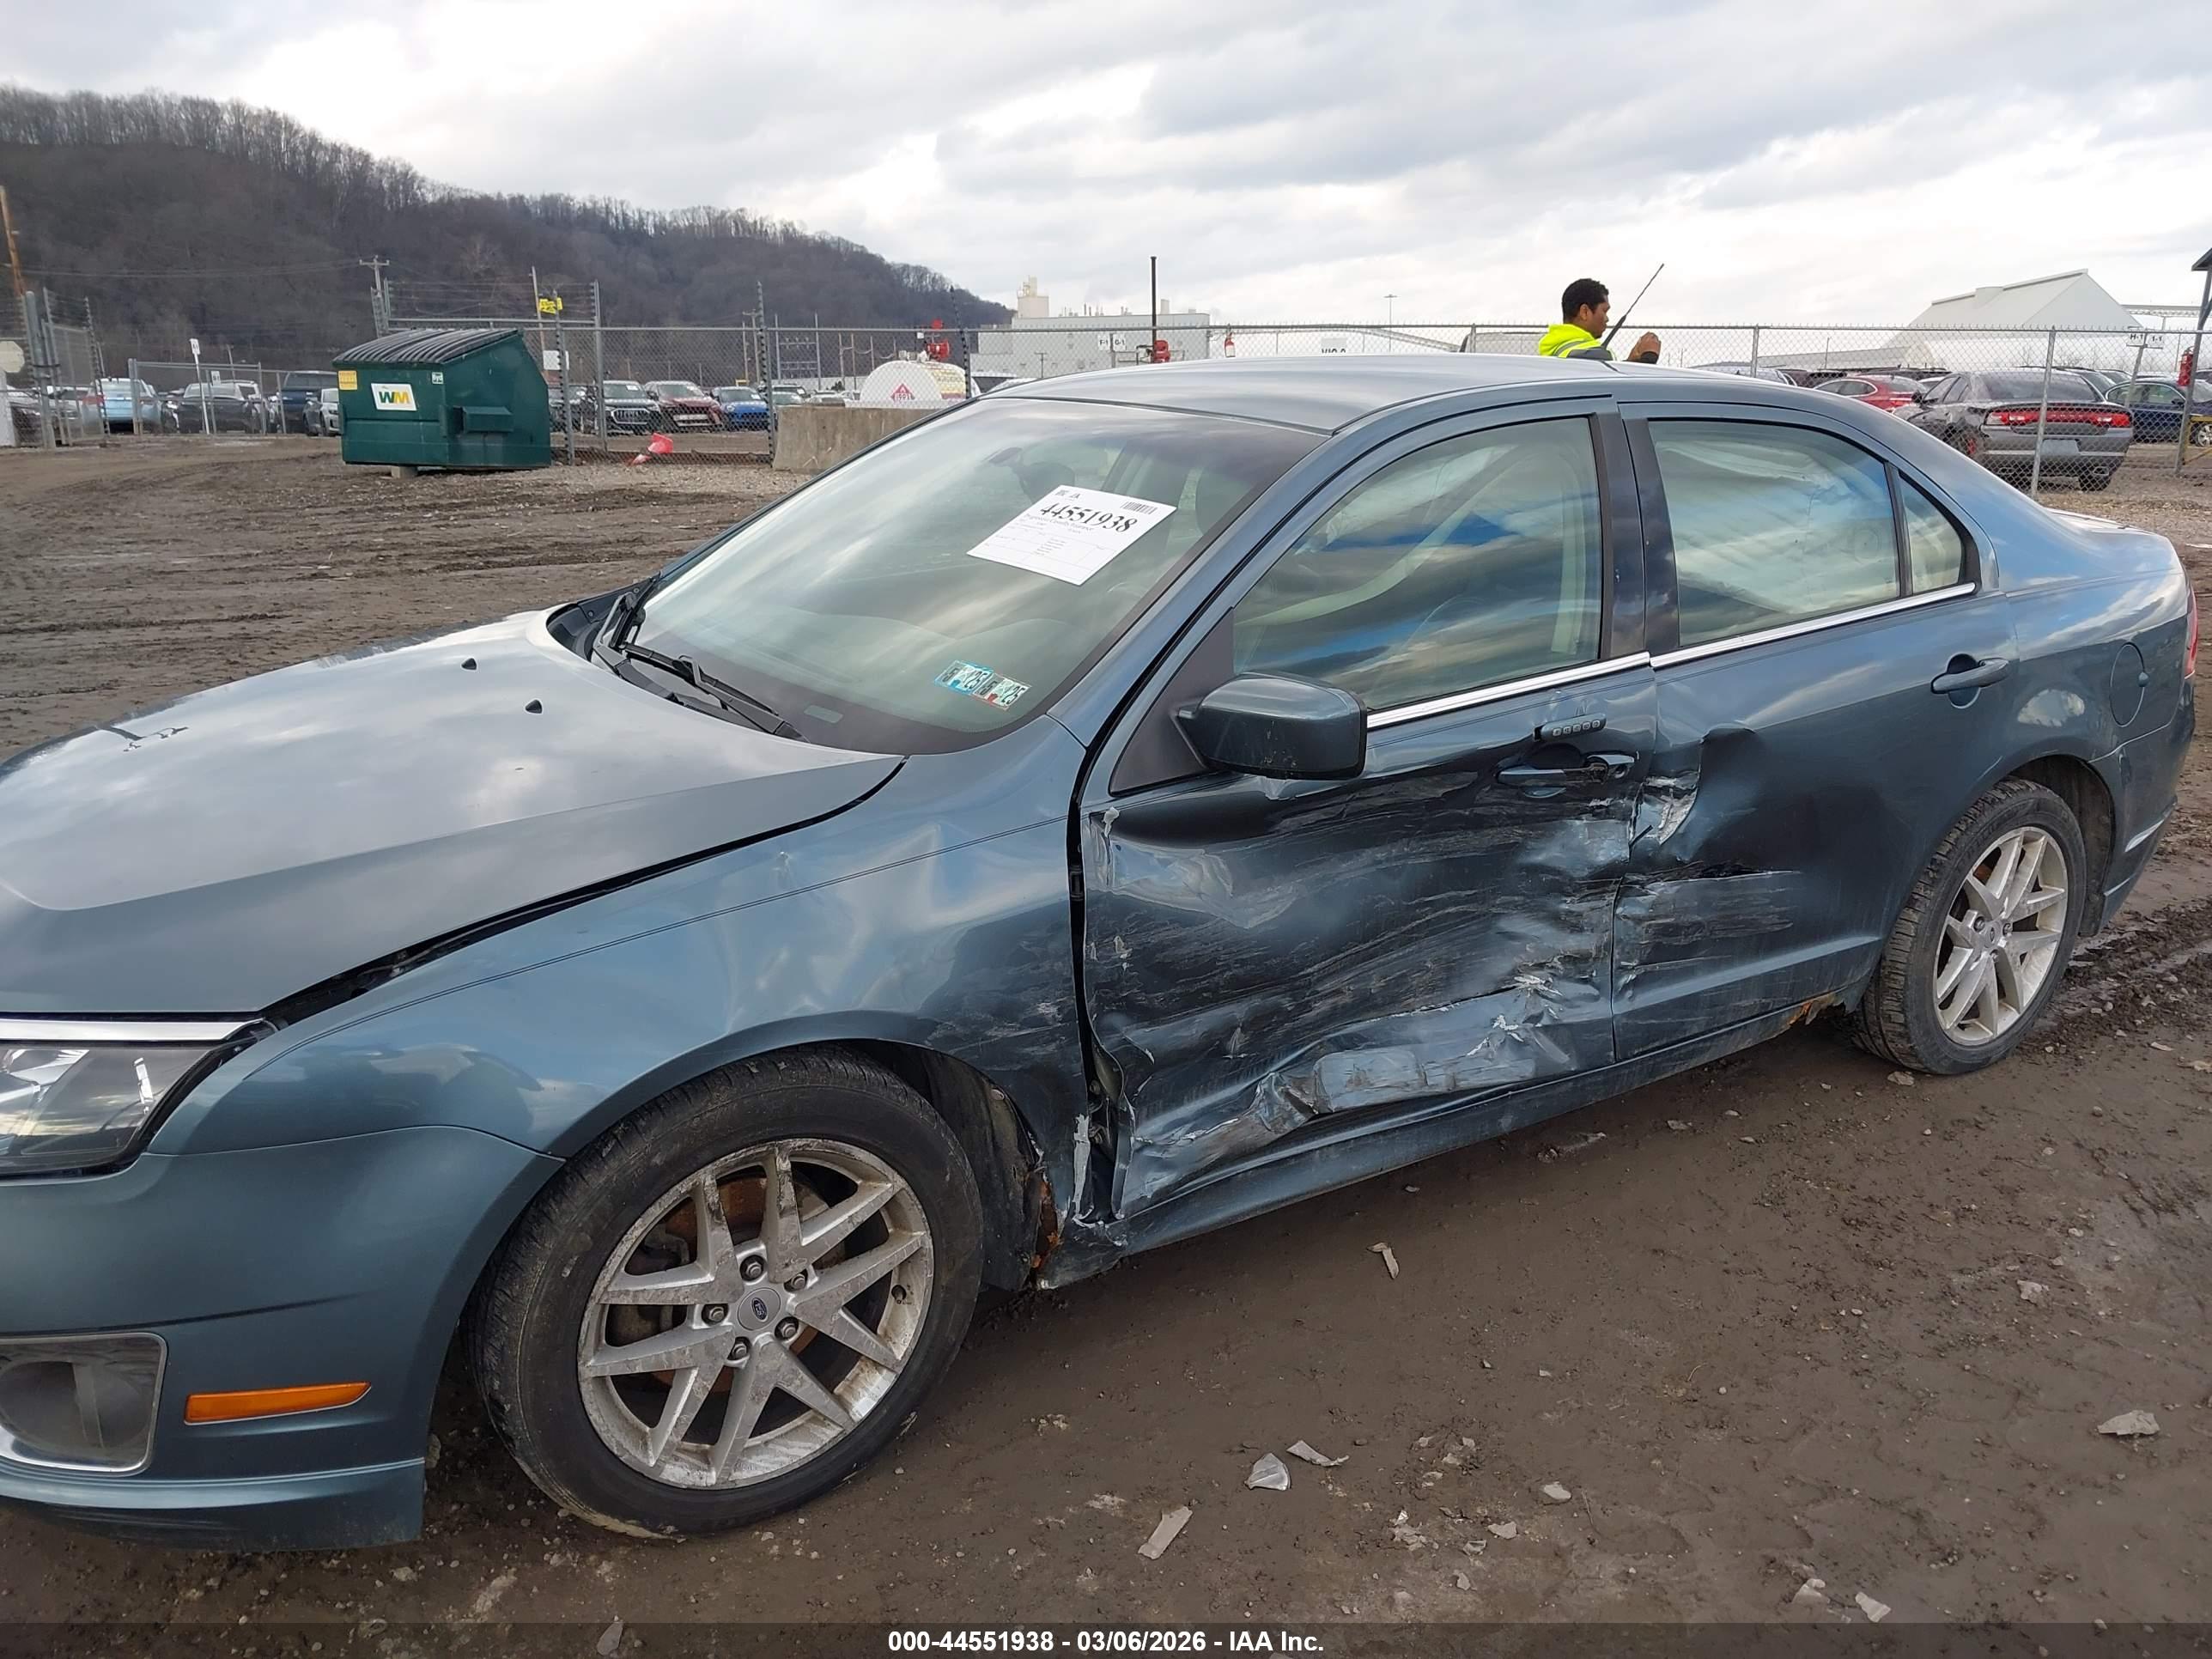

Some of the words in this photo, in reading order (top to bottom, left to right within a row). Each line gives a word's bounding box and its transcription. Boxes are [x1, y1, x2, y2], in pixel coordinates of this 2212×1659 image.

[378, 391, 410, 404] WM
[1039, 502, 1139, 533] 44551938
[964, 671, 988, 690] 25
[1001, 686, 1025, 705] 25
